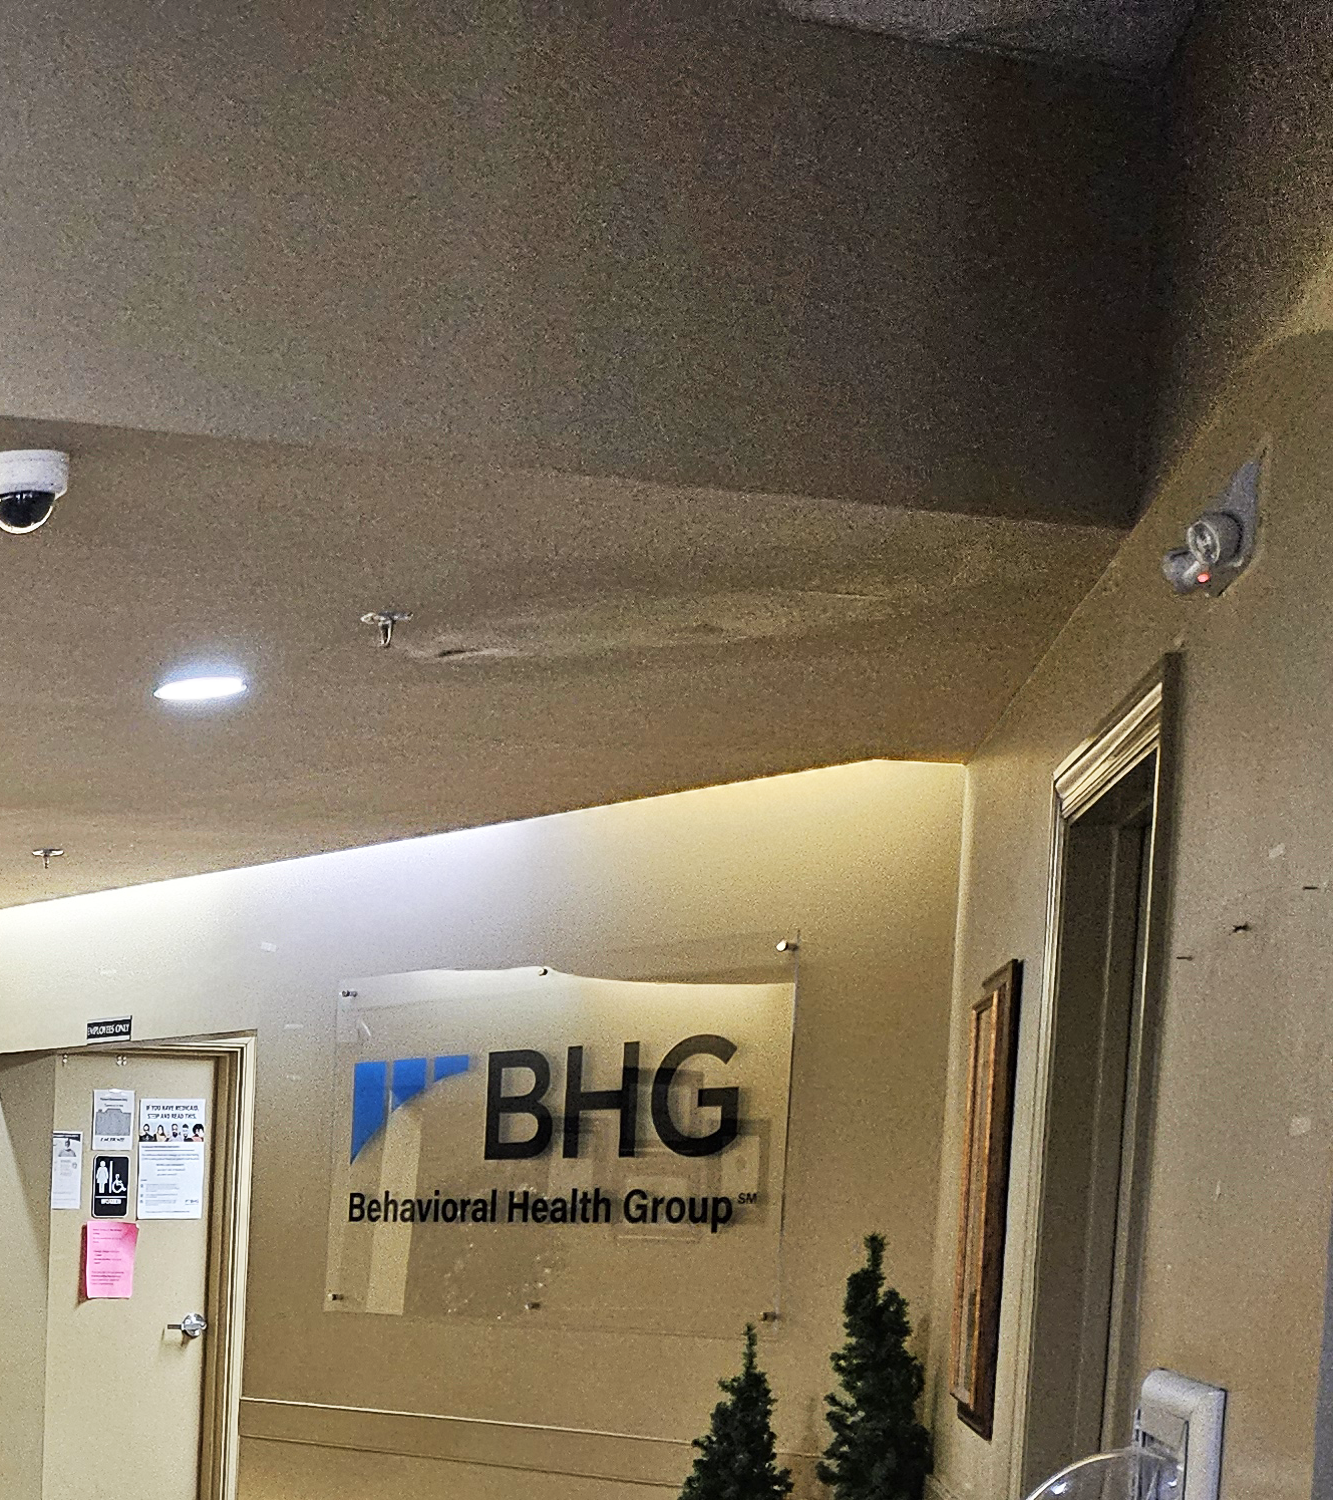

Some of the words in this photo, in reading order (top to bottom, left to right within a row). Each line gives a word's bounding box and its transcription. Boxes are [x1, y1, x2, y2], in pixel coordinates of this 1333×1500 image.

[115, 1023, 130, 1034] ONLY
[484, 1033, 740, 1160] BHG
[348, 1188, 498, 1223] Behavioral
[508, 1187, 611, 1224] Health
[623, 1189, 733, 1234] Group
